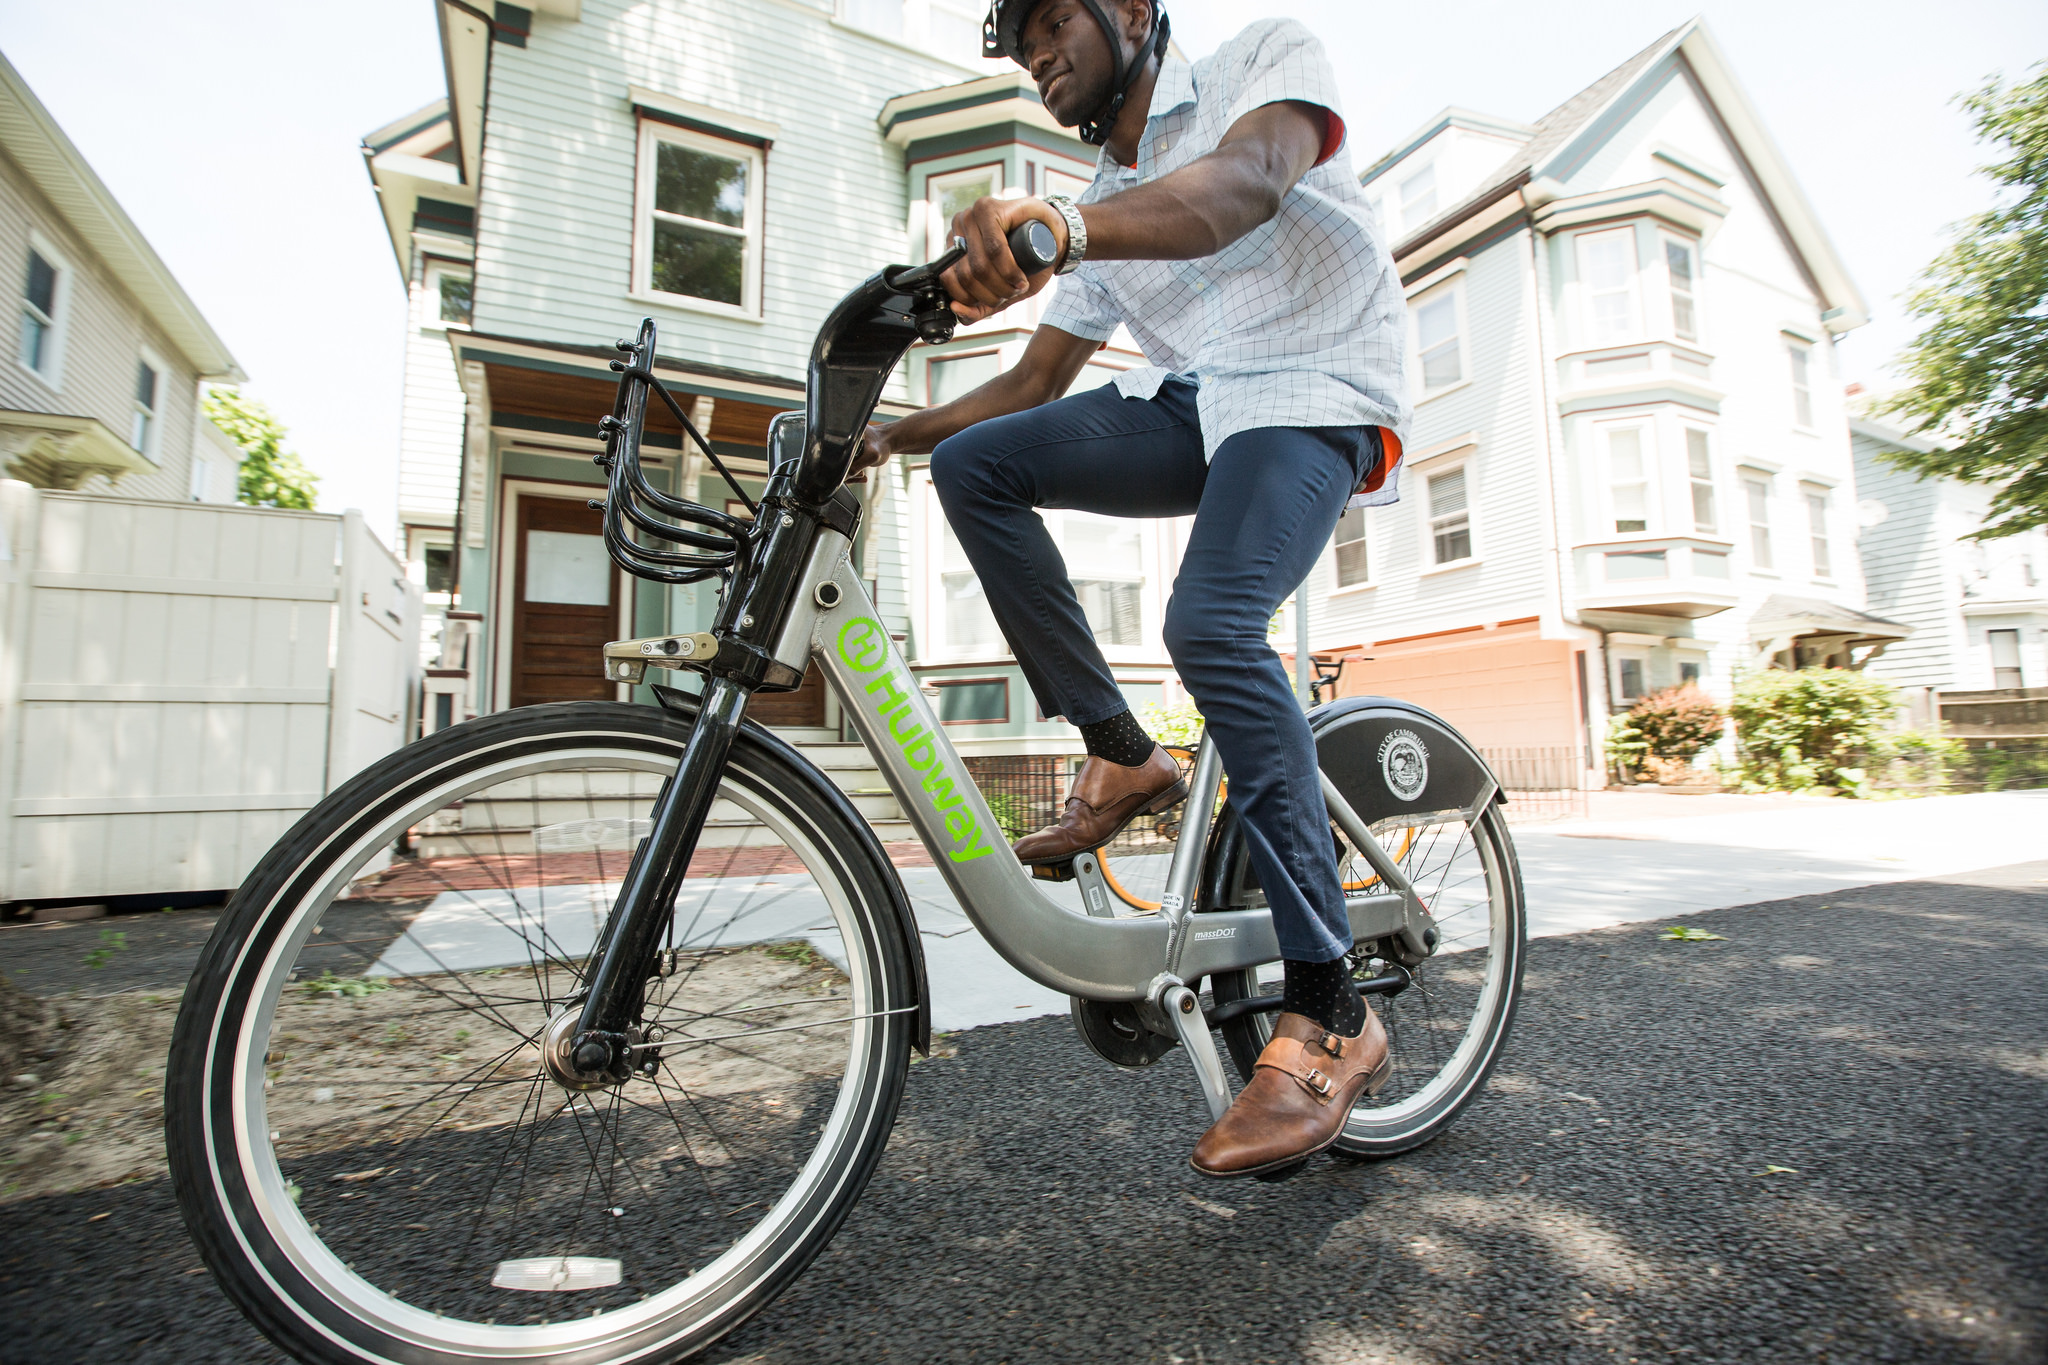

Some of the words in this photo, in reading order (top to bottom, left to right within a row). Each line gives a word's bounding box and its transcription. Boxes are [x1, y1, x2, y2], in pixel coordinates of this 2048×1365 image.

[1377, 740, 1387, 763] CITY
[1384, 733, 1394, 743] OF
[1394, 729, 1430, 759] CAMBRIDGE
[865, 668, 994, 863] Hubway
[1195, 928, 1236, 939] massDOT
